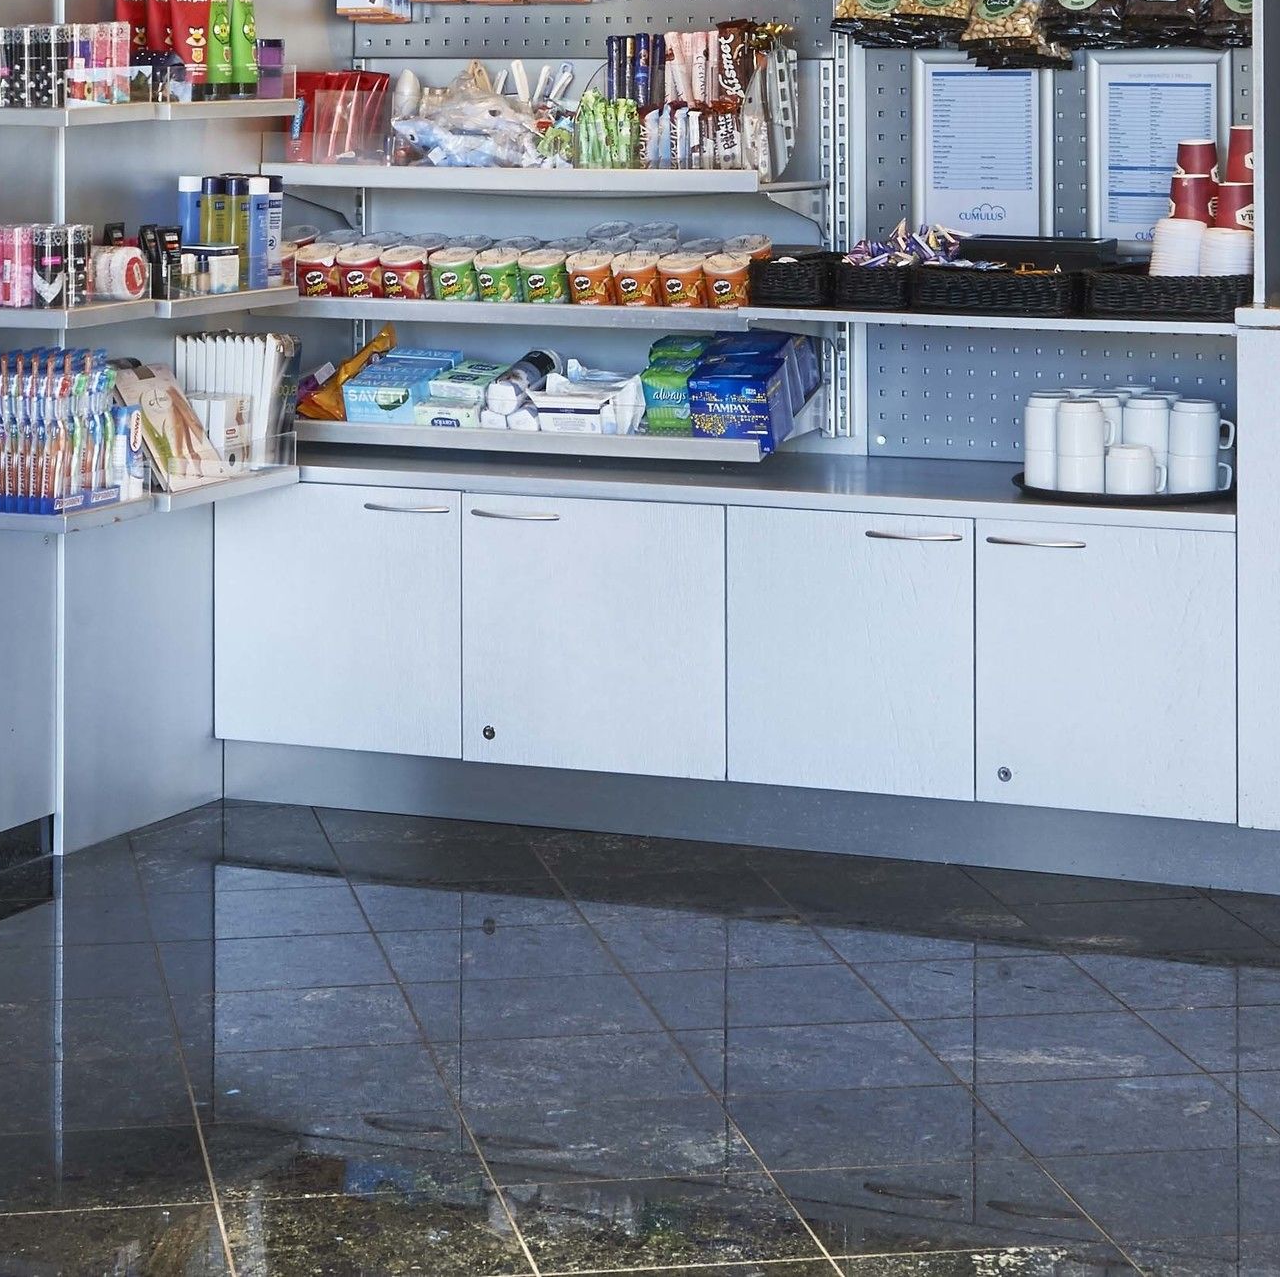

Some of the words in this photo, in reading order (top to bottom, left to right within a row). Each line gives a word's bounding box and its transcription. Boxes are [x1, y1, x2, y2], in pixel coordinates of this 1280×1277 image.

[719, 33, 746, 98] Kismet
[958, 210, 1005, 221] CUMULUS
[348, 388, 406, 403] SAVETT
[652, 387, 686, 405] always
[707, 402, 751, 414] TAMPAX
